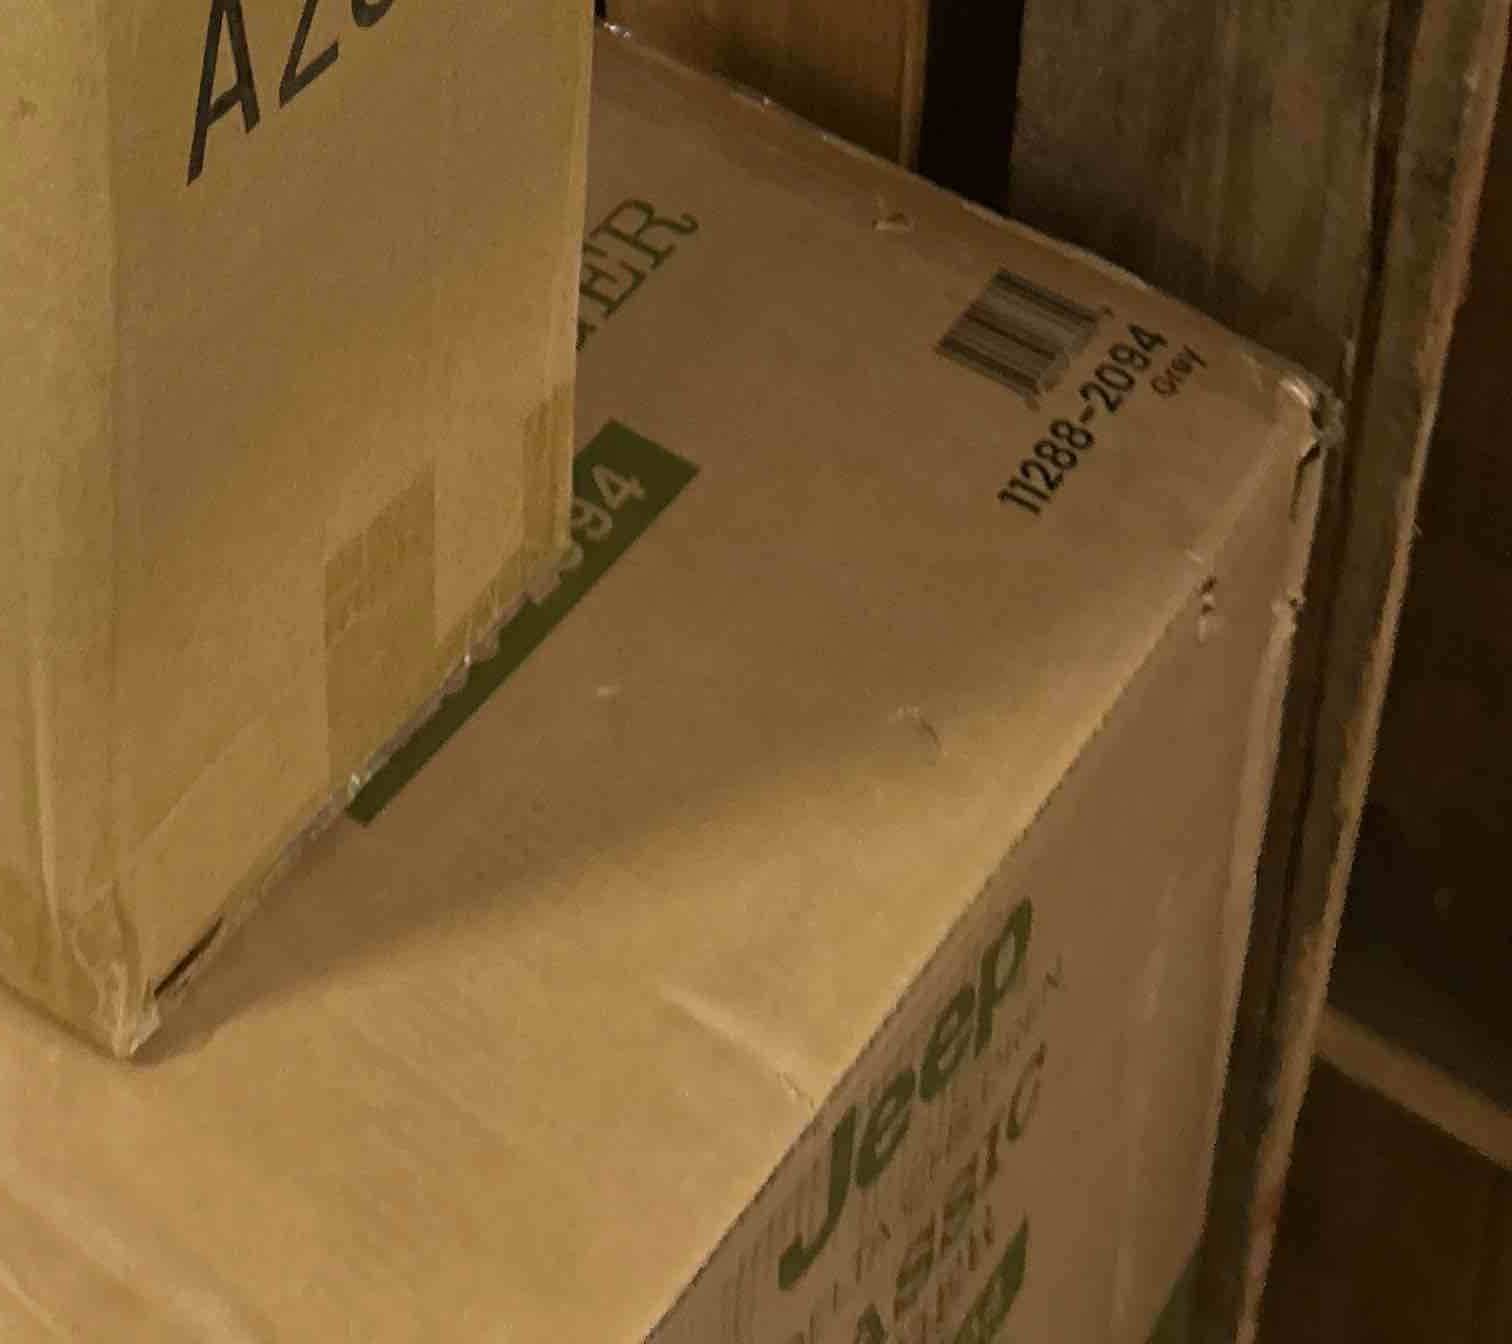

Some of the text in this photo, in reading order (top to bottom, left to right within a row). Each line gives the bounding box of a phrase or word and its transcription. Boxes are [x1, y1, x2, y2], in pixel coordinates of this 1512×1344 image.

[574, 197, 700, 353] ER
[997, 322, 1169, 517] 11288-2094
[777, 894, 1034, 1292] Jeep
